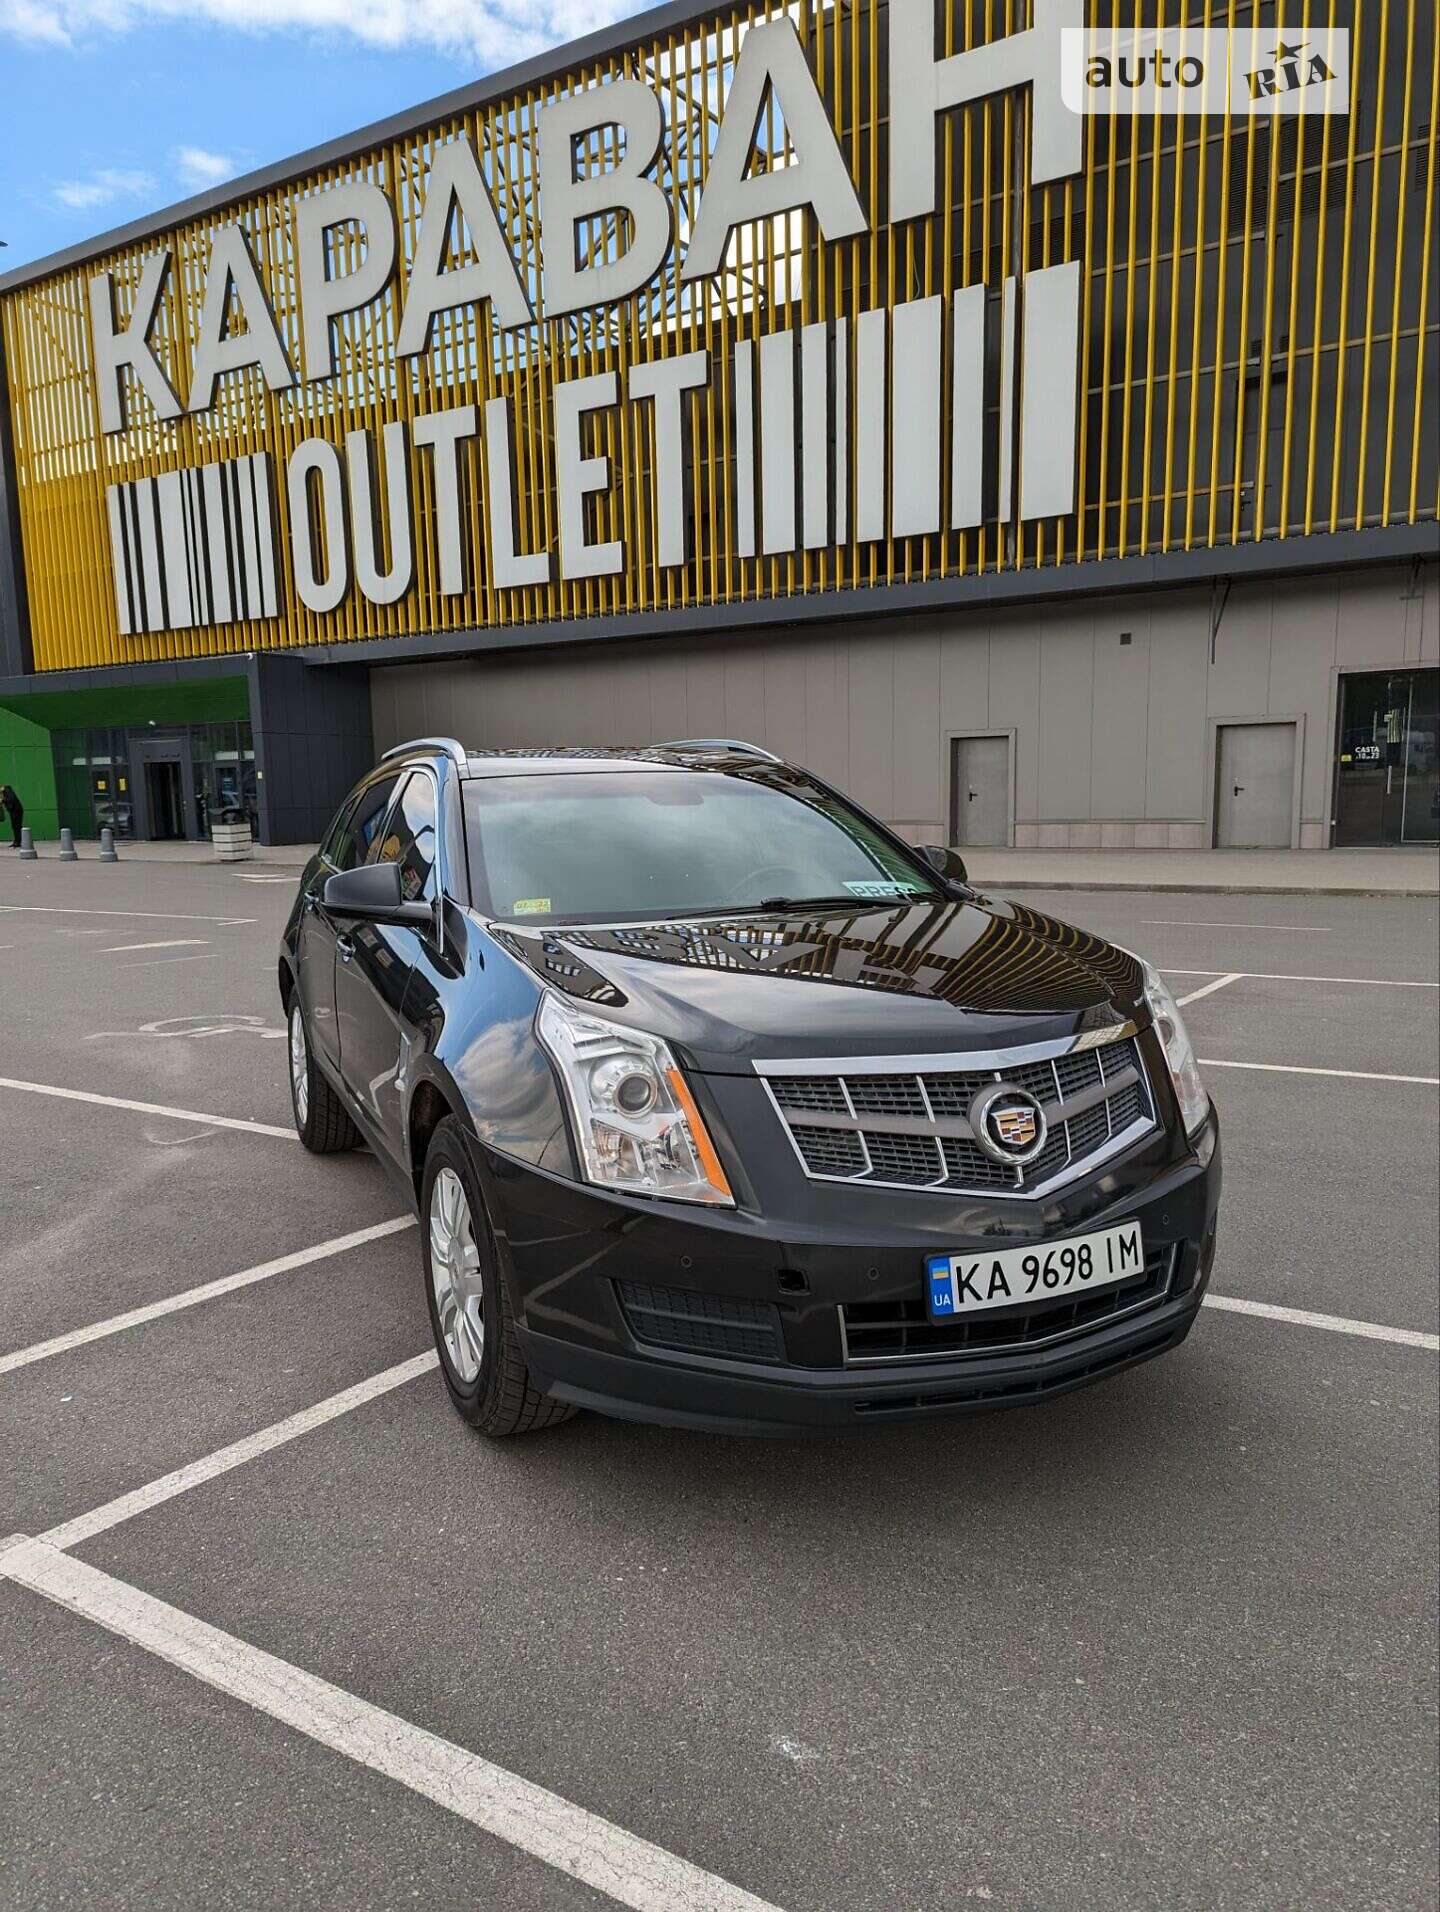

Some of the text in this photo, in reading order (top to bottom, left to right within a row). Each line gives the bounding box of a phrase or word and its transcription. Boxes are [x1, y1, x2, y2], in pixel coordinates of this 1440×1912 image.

[89, 0, 1086, 433] КАРАВАН
[287, 349, 709, 615] OUTLET
[934, 1294, 951, 1307] UA
[956, 1230, 1139, 1304] KA 9698 IM
